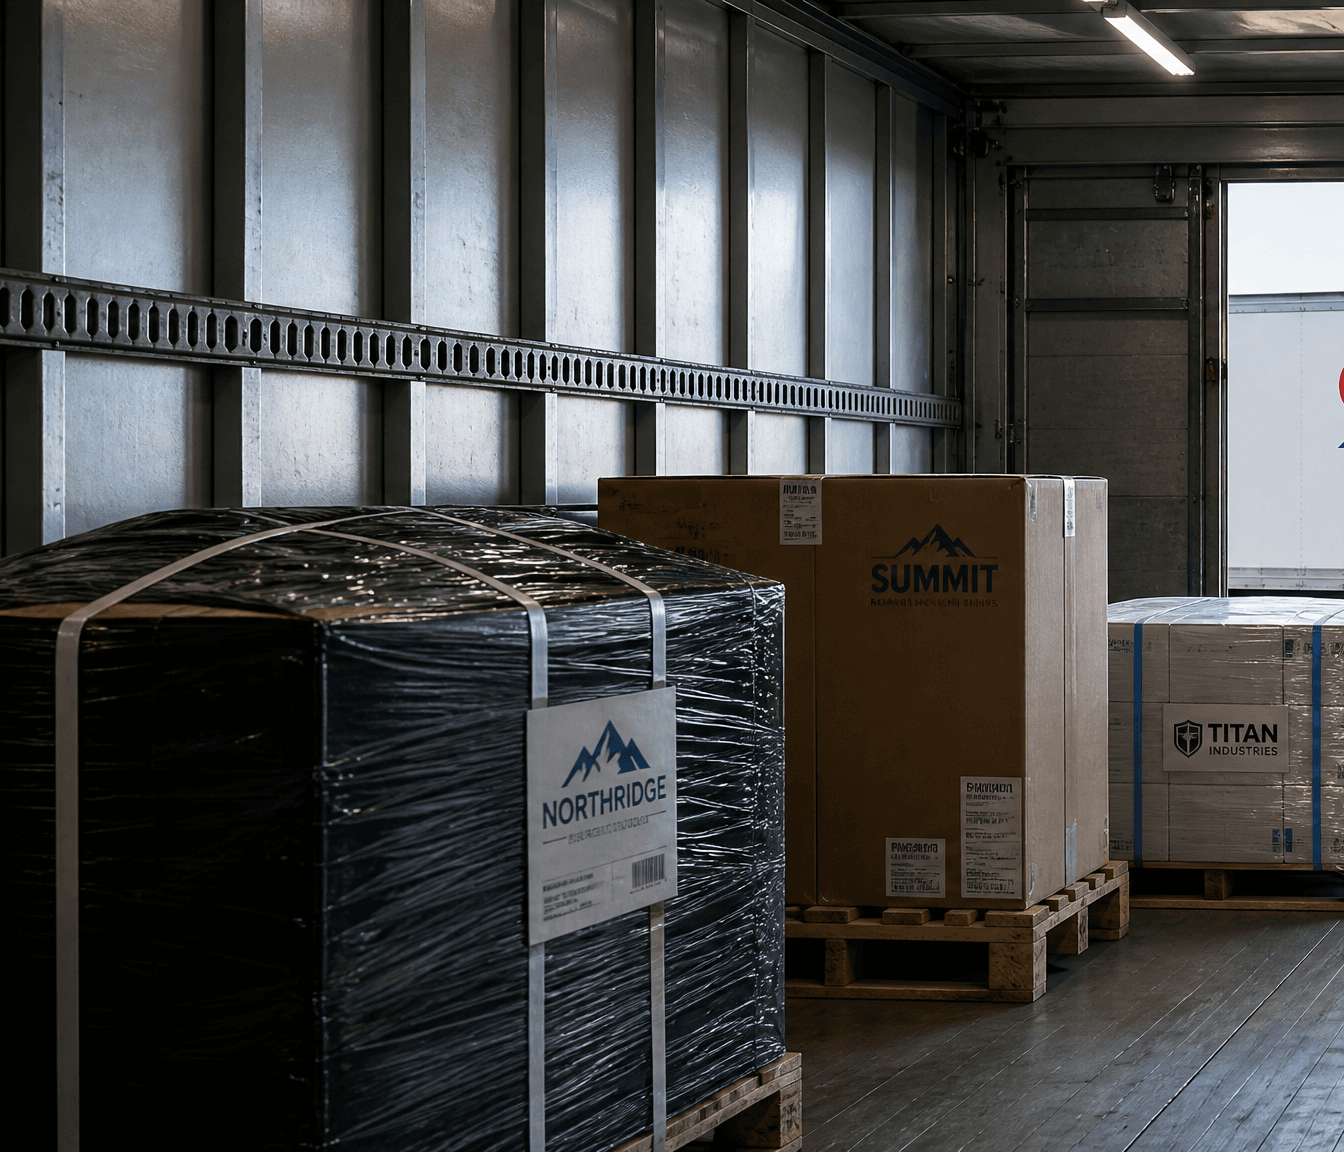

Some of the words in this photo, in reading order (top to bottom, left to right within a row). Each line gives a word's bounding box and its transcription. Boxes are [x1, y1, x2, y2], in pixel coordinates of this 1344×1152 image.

[871, 563, 999, 593] SUMMIT
[1207, 723, 1278, 743] TITAN
[1209, 746, 1278, 756] INDUSTRIES
[542, 775, 667, 829] NORTHRIDGE
